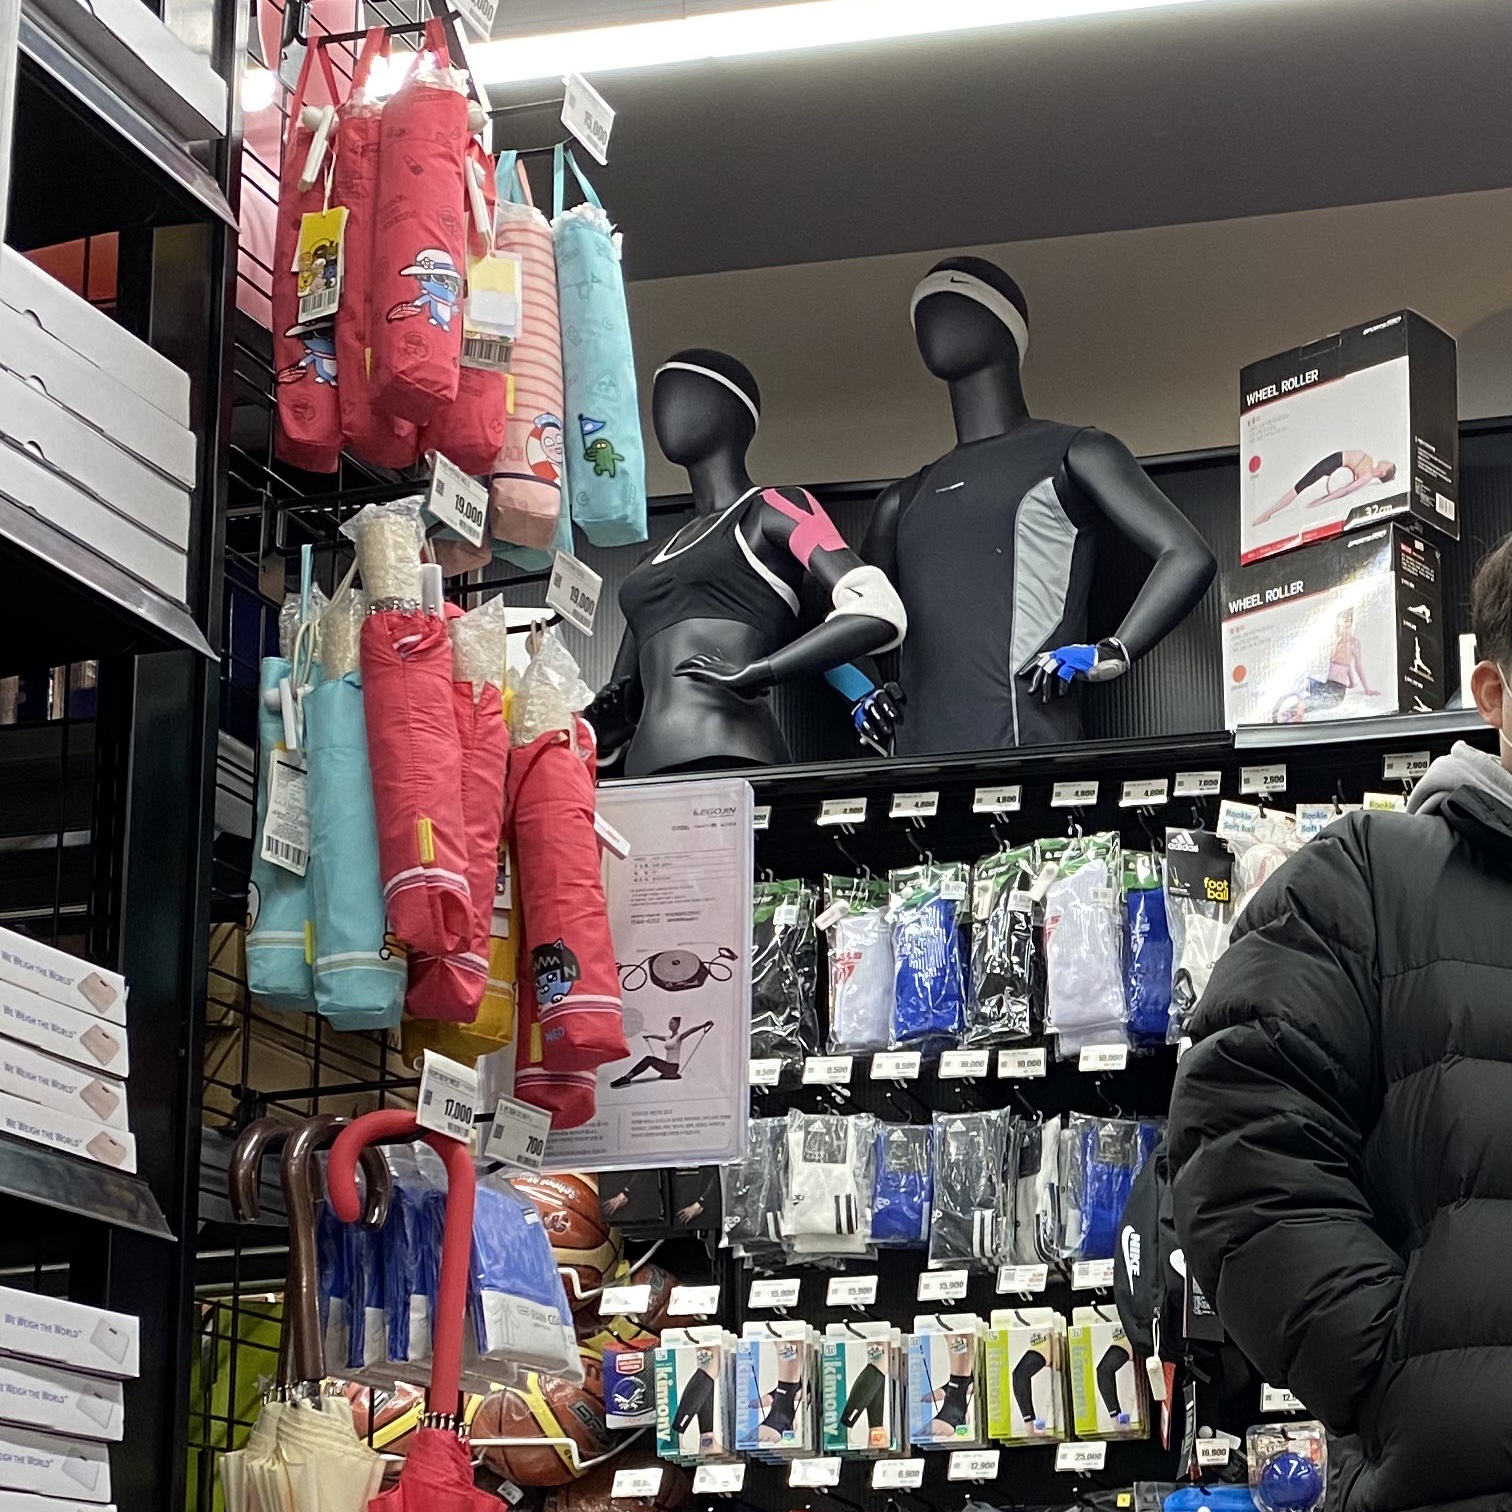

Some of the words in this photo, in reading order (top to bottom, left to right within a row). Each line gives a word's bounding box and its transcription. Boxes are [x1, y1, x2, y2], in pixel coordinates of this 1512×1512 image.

[1246, 383, 1279, 407] WHEEL
[1281, 368, 1319, 393] ROLLER
[1228, 596, 1263, 614] WHEEL
[1265, 580, 1304, 604] ROLLER
[1301, 808, 1328, 820] Rookie
[1203, 876, 1229, 890] foot
[1206, 887, 1230, 902] ball
[525, 1134, 544, 1157] 700
[1129, 1232, 1141, 1277] NIKE
[655, 1366, 674, 1443] kimony
[824, 1359, 841, 1436] kimony
